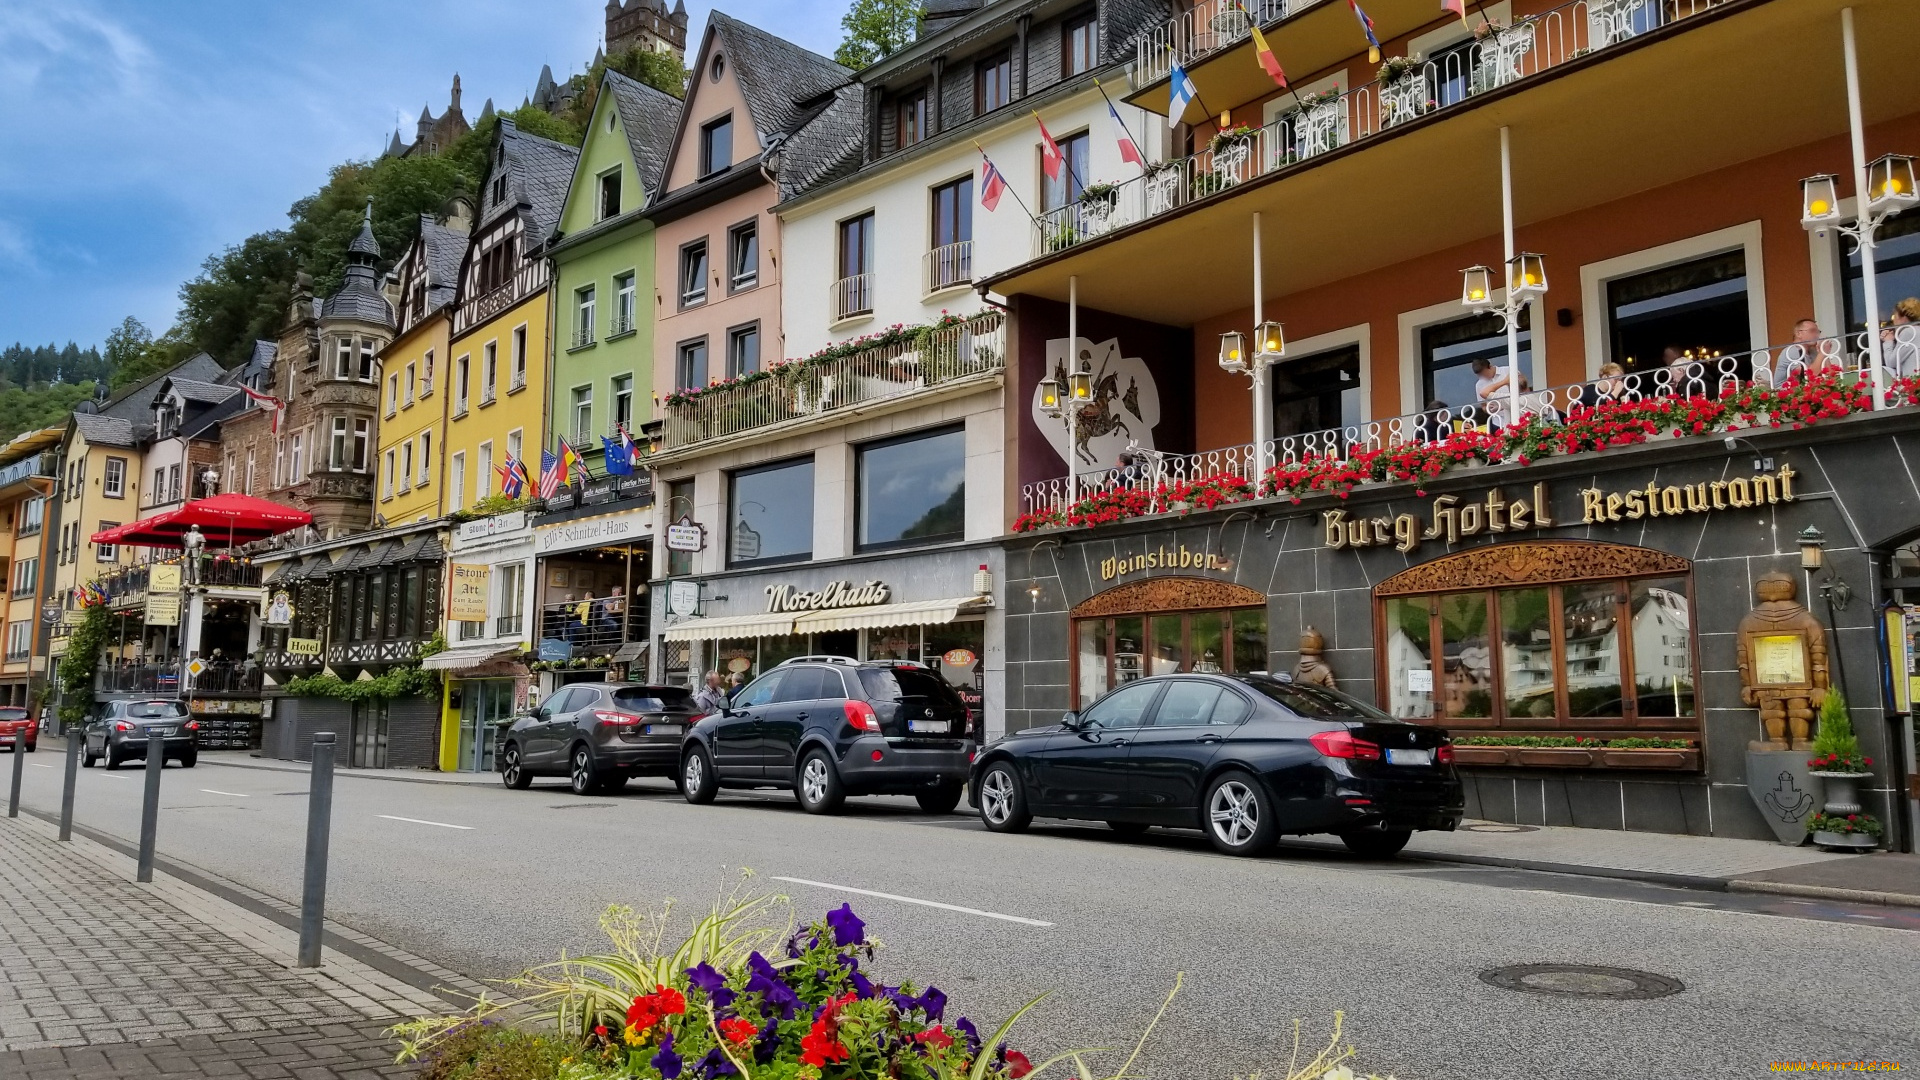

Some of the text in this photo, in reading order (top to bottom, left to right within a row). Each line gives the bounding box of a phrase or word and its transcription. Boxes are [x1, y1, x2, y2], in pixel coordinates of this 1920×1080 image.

[1323, 462, 1796, 553] Burg Hotel Restaurant
[455, 566, 487, 578] Stone
[1100, 544, 1218, 580] Weinstuben
[461, 583, 479, 594] Art
[764, 580, 893, 613] Moselhaus
[291, 641, 318, 652] Hotel
